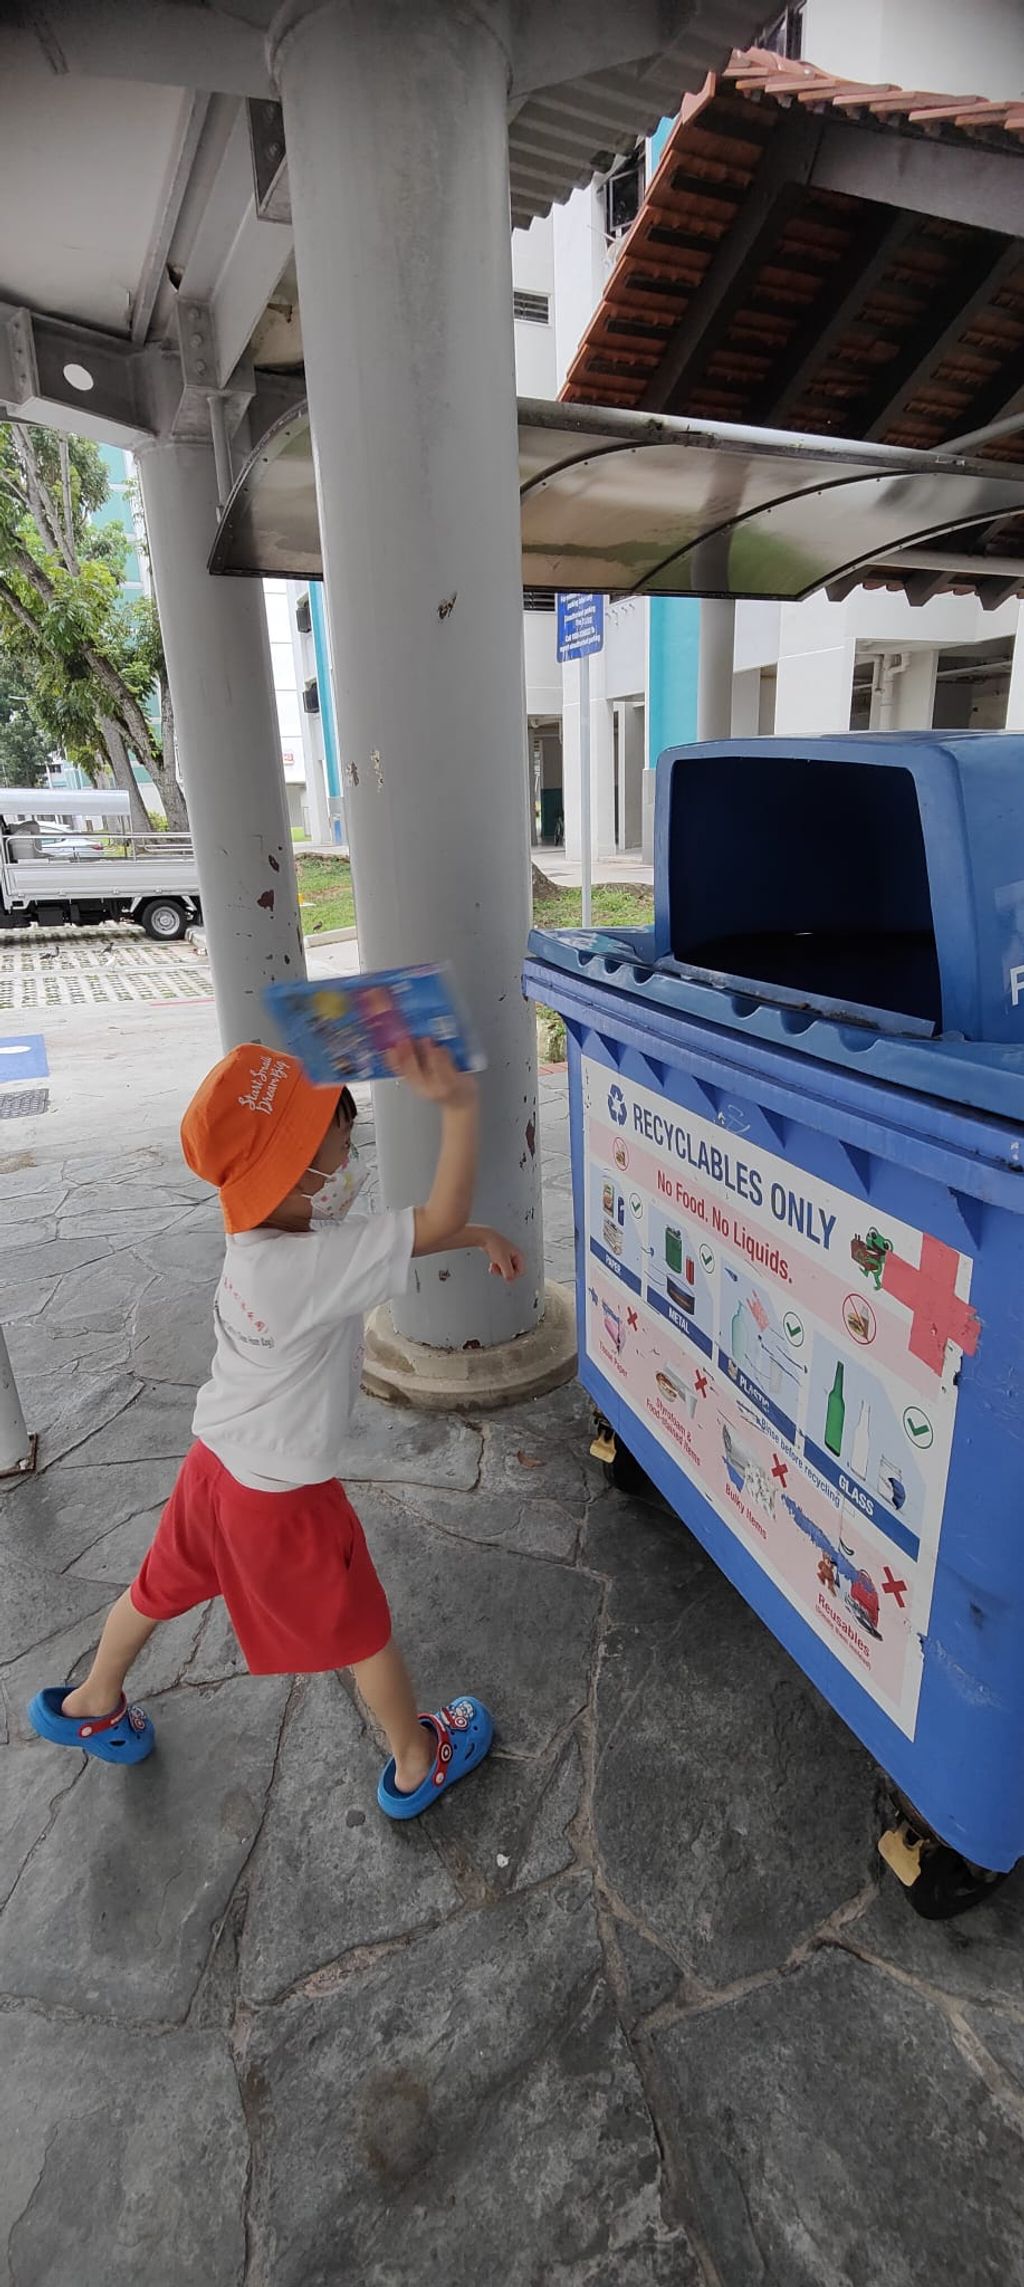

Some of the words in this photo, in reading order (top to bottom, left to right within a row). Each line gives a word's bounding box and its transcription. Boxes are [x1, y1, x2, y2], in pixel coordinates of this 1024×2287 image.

[632, 1102, 763, 1206] RECYCLABLES
[770, 1182, 837, 1251] ONLY
[657, 1169, 673, 1197] No
[675, 1181, 709, 1223] Food.
[712, 1206, 730, 1237] No
[733, 1221, 794, 1284] Liquids.
[668, 1307, 691, 1335] METAL
[780, 1440, 804, 1471] before
[804, 1465, 841, 1509] recycling
[837, 1474, 875, 1516] GLASS
[724, 1482, 745, 1516] Bulky
[745, 1506, 768, 1540] Items
[817, 1593, 871, 1657] Reusables
